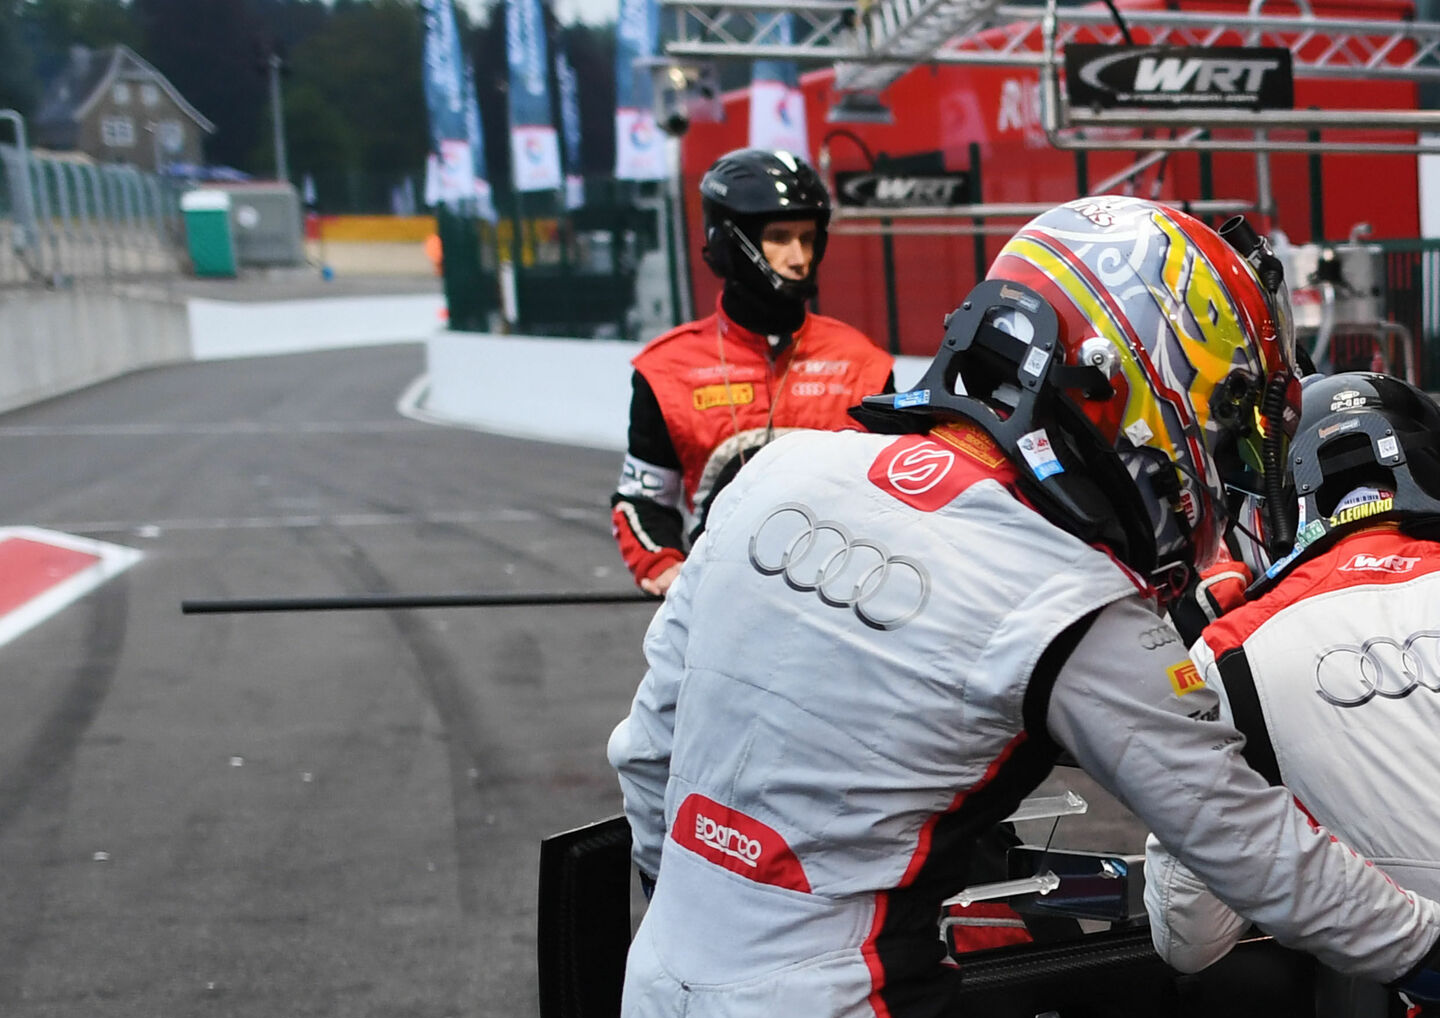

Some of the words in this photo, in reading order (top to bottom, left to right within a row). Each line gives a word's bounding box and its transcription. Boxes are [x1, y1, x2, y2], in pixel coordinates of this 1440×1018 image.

[1134, 57, 1279, 92] WRT
[875, 176, 964, 202] WRT
[1180, 491, 1195, 524] BELL
[1329, 497, 1393, 528] S.LEONARD
[1354, 555, 1421, 571] WRT
[694, 812, 762, 862] sparco
